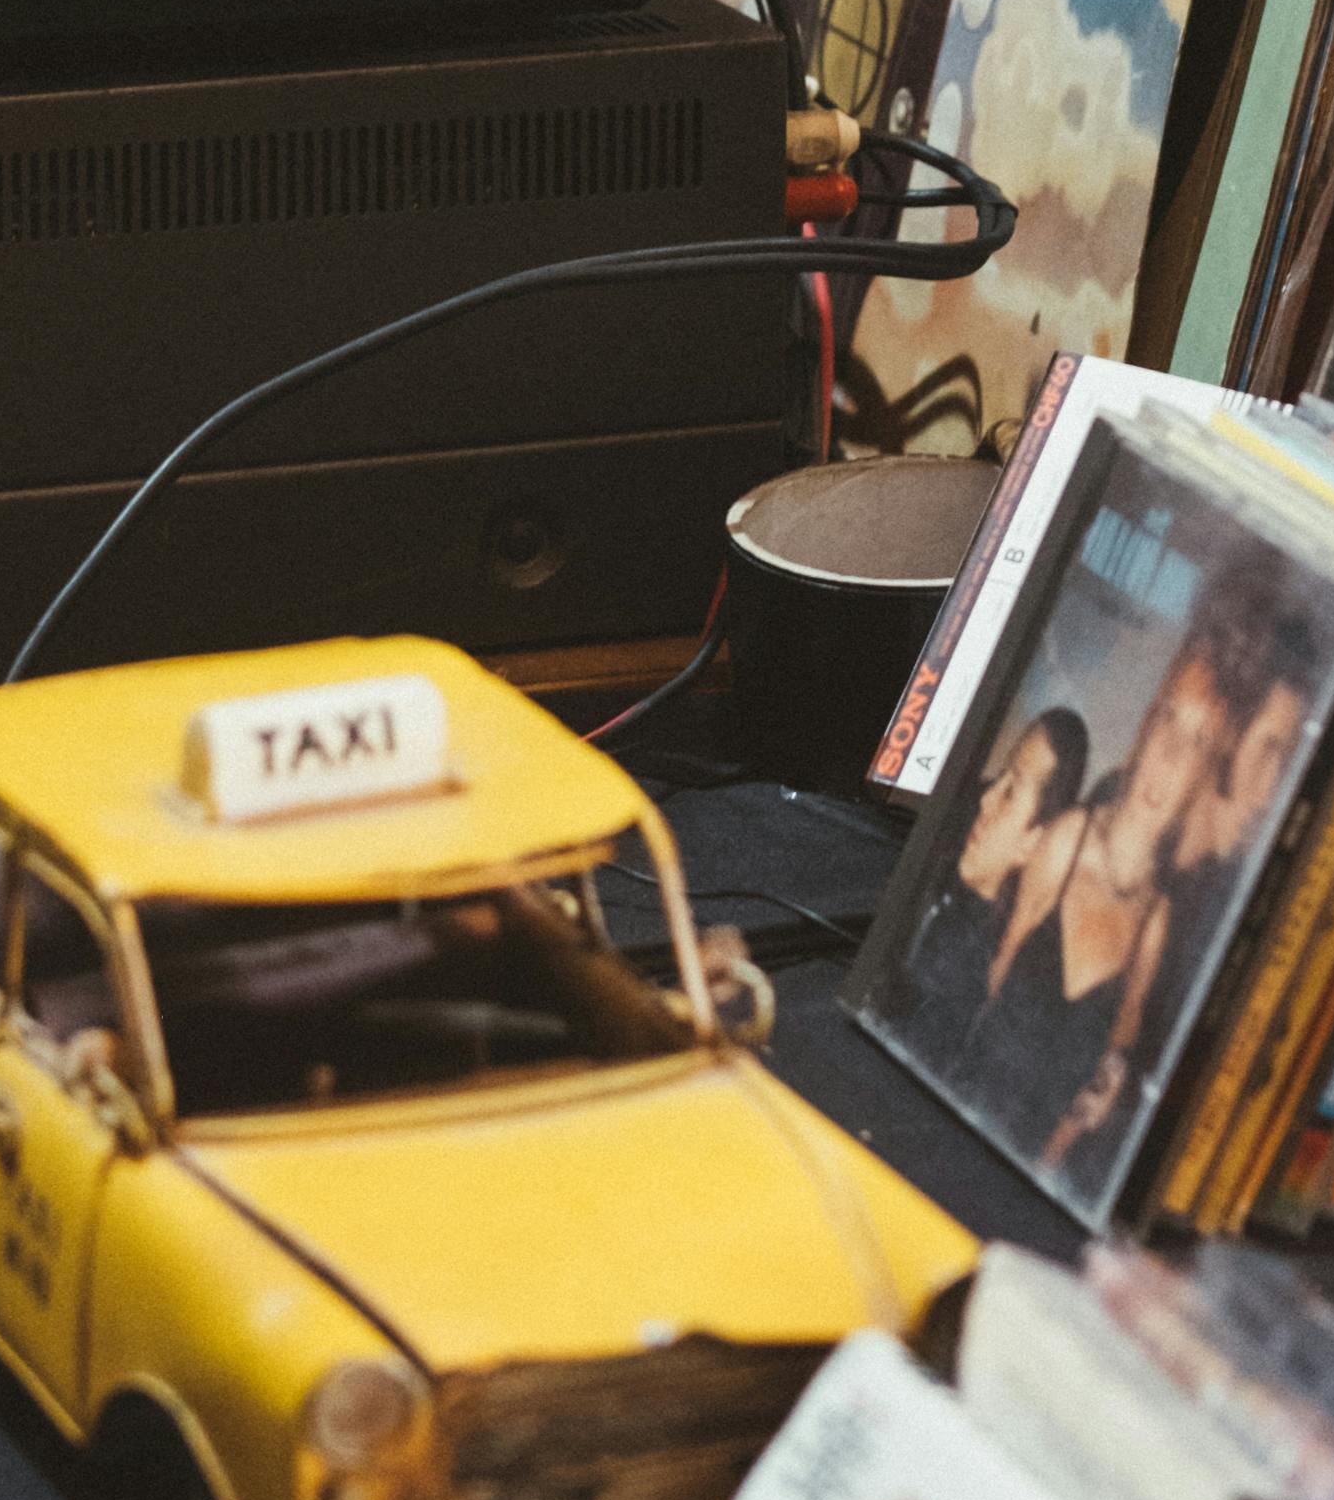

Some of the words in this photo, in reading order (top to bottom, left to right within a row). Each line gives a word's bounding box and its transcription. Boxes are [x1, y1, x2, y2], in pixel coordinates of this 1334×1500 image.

[1004, 546, 1025, 564] B
[255, 704, 397, 776] TAXI
[878, 661, 942, 778] SONY
[915, 753, 937, 772] A
